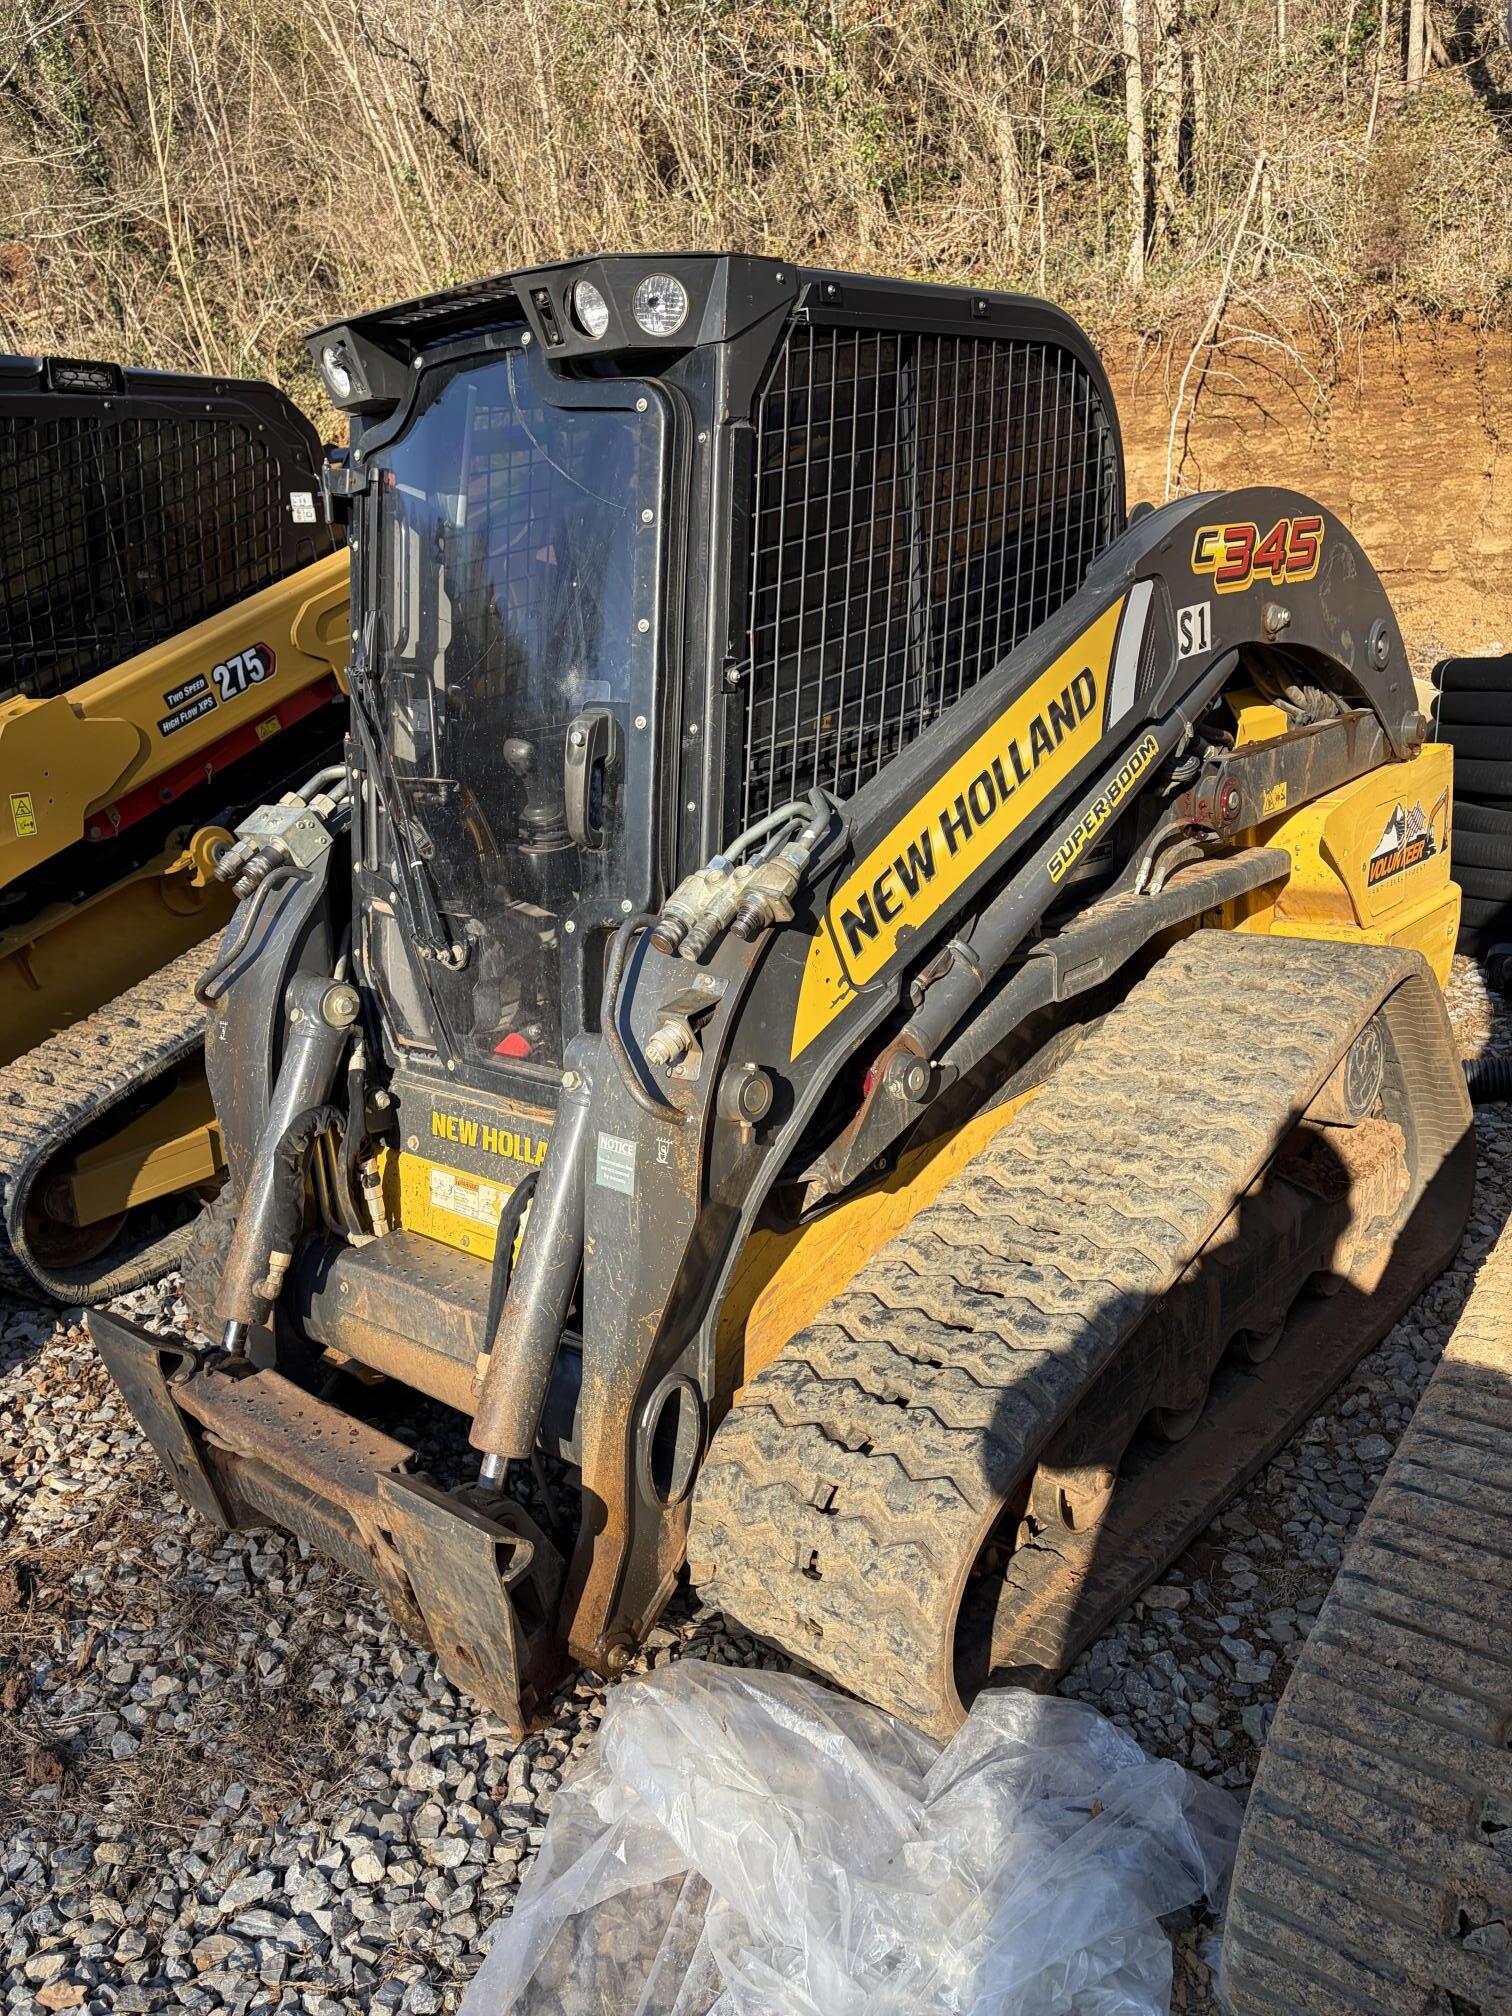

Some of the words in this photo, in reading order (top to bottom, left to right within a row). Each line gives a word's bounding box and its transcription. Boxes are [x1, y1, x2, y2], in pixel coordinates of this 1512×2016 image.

[1193, 516, 1323, 590] C345
[1180, 606, 1207, 655] S1
[213, 648, 265, 701] 275
[199, 696, 214, 712] XPS
[839, 827, 937, 959] NEW
[938, 666, 1098, 855] HOLLAND
[431, 1110, 479, 1148] NEW
[482, 1124, 549, 1167] HOLLA
[600, 1135, 634, 1156] NOTICE
